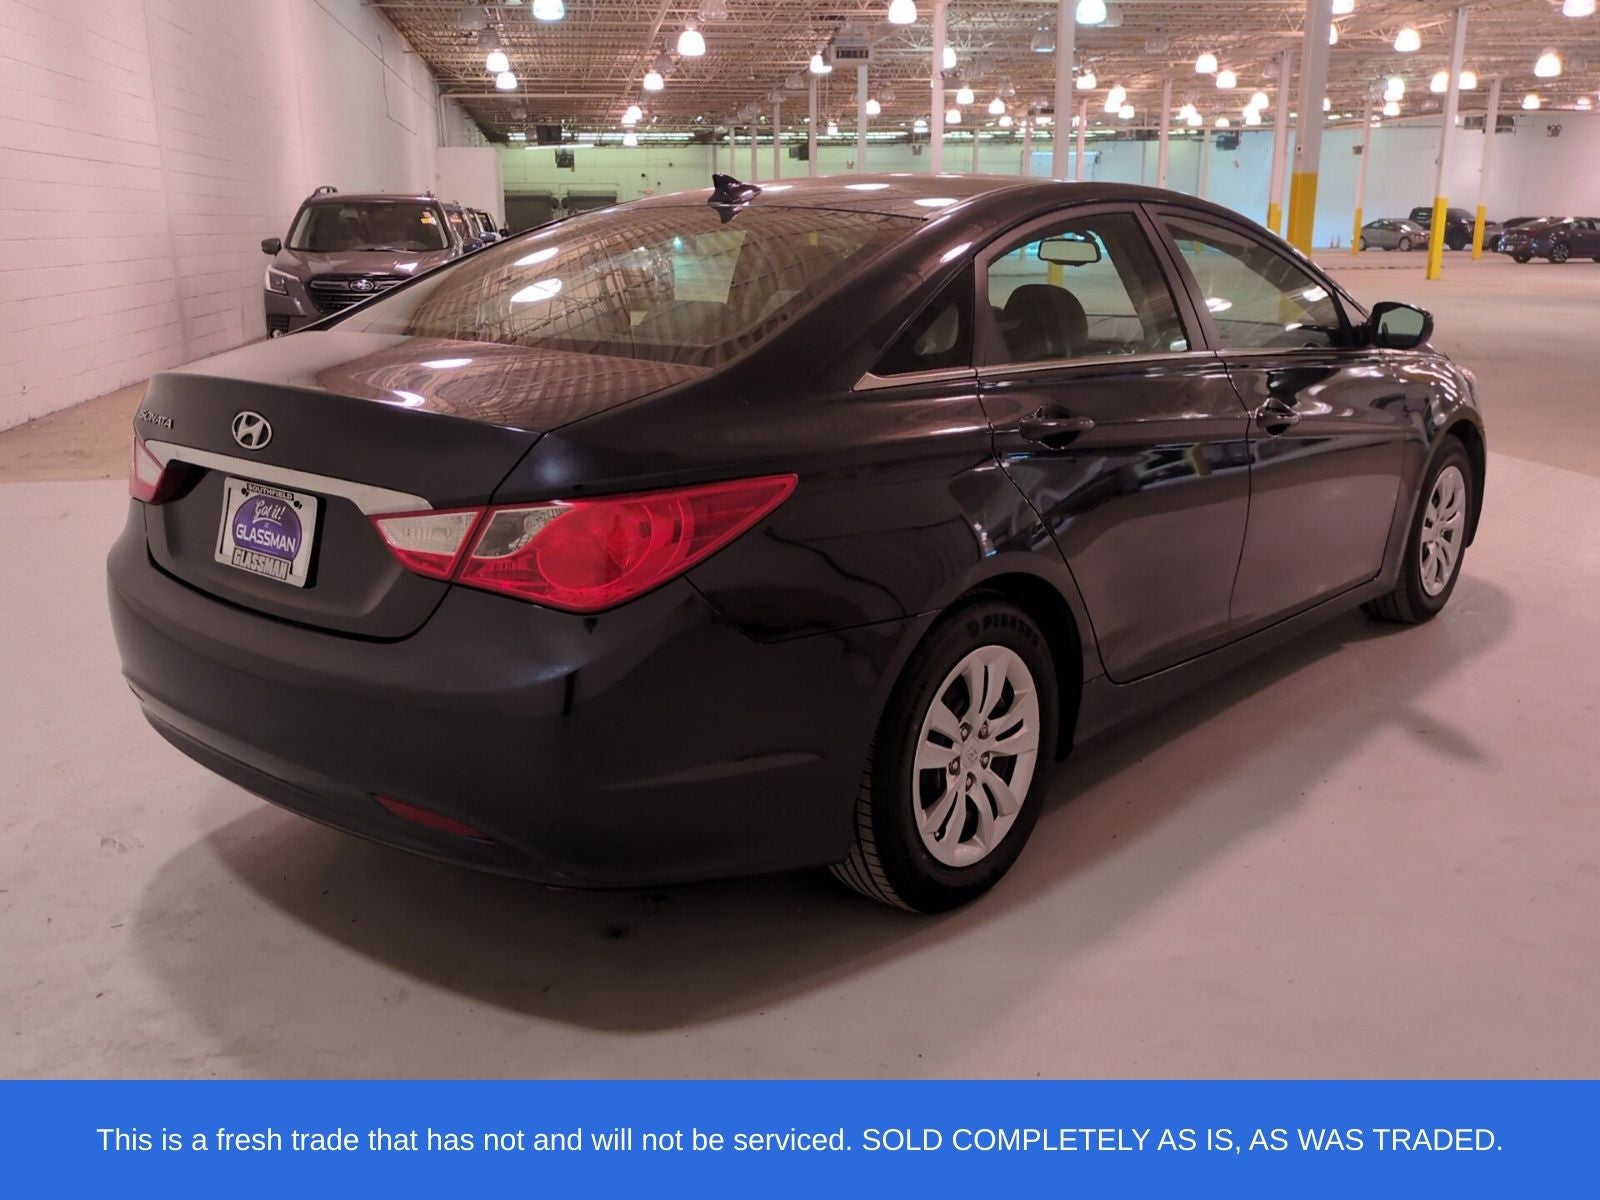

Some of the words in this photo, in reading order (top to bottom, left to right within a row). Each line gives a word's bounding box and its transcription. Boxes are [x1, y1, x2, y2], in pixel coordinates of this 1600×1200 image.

[136, 409, 174, 430] SONATA
[247, 483, 294, 501] SOUTHFIELD
[255, 499, 272, 519] Got
[272, 505, 286, 521] it!
[235, 523, 297, 553] GLASSMAN
[233, 548, 289, 579] GLASSMAN
